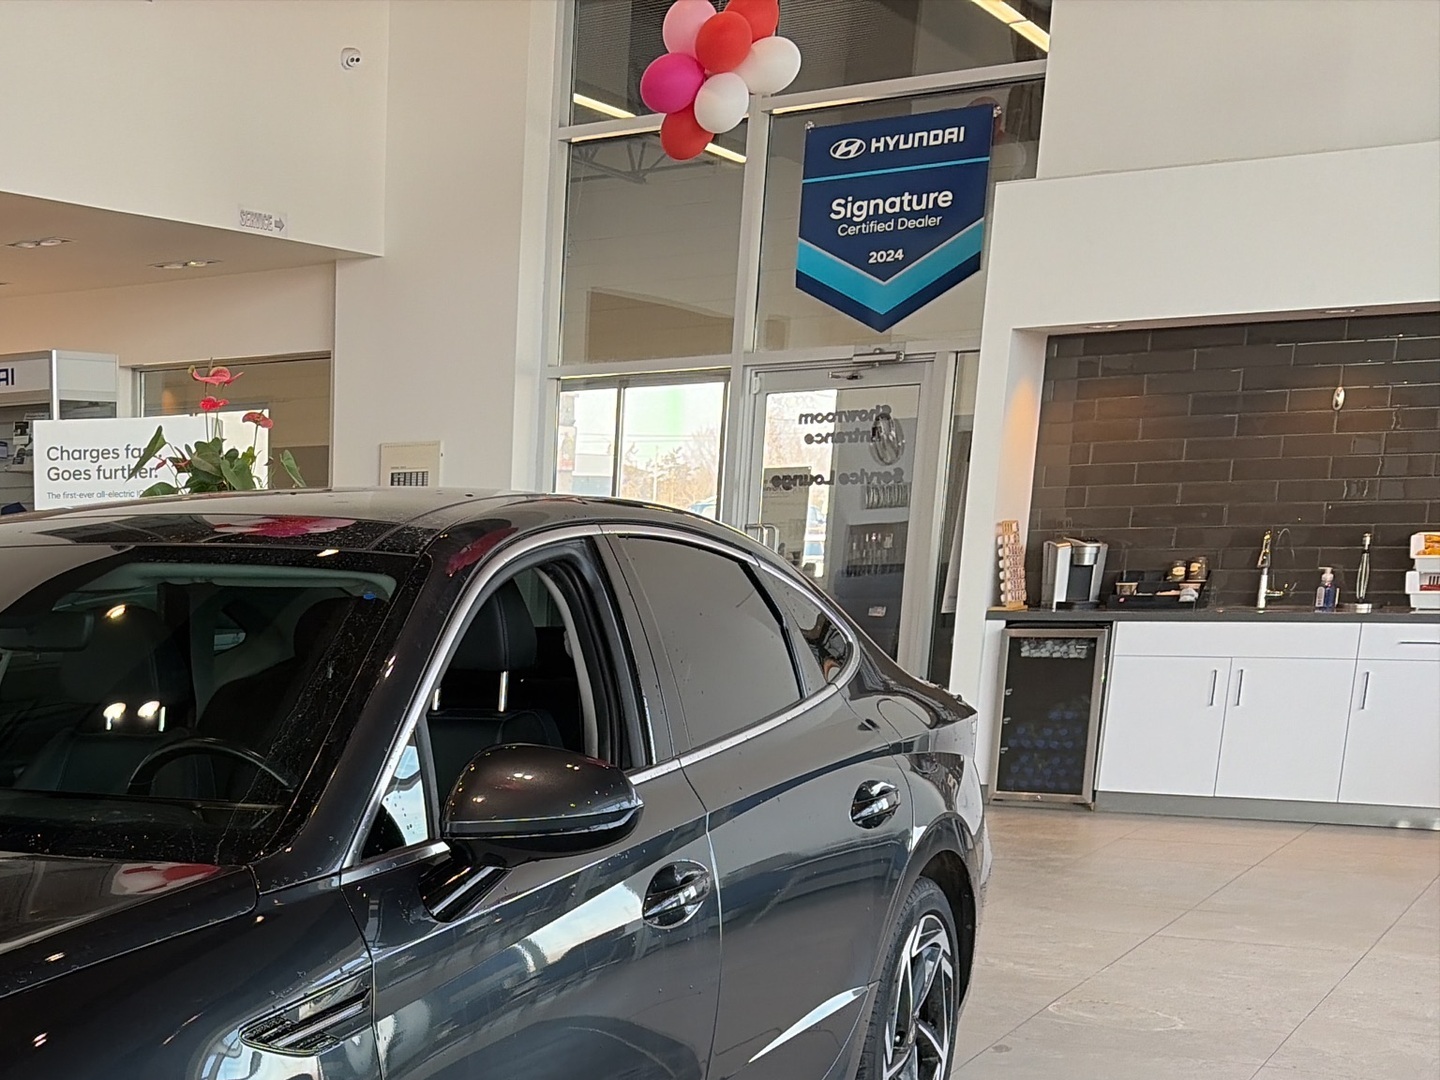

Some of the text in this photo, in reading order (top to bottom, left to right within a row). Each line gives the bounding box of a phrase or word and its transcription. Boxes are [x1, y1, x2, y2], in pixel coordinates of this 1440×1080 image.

[870, 126, 965, 153] HYUNDAI
[829, 190, 953, 222] Signature
[240, 209, 273, 232] SERVICE
[837, 214, 942, 236] Certified Dealer
[868, 249, 904, 264] 2024
[46, 444, 162, 464] Charges fa.
[47, 464, 158, 481] Goes further.
[63, 491, 95, 499] first-ever
[96, 490, 135, 498] all-electric
